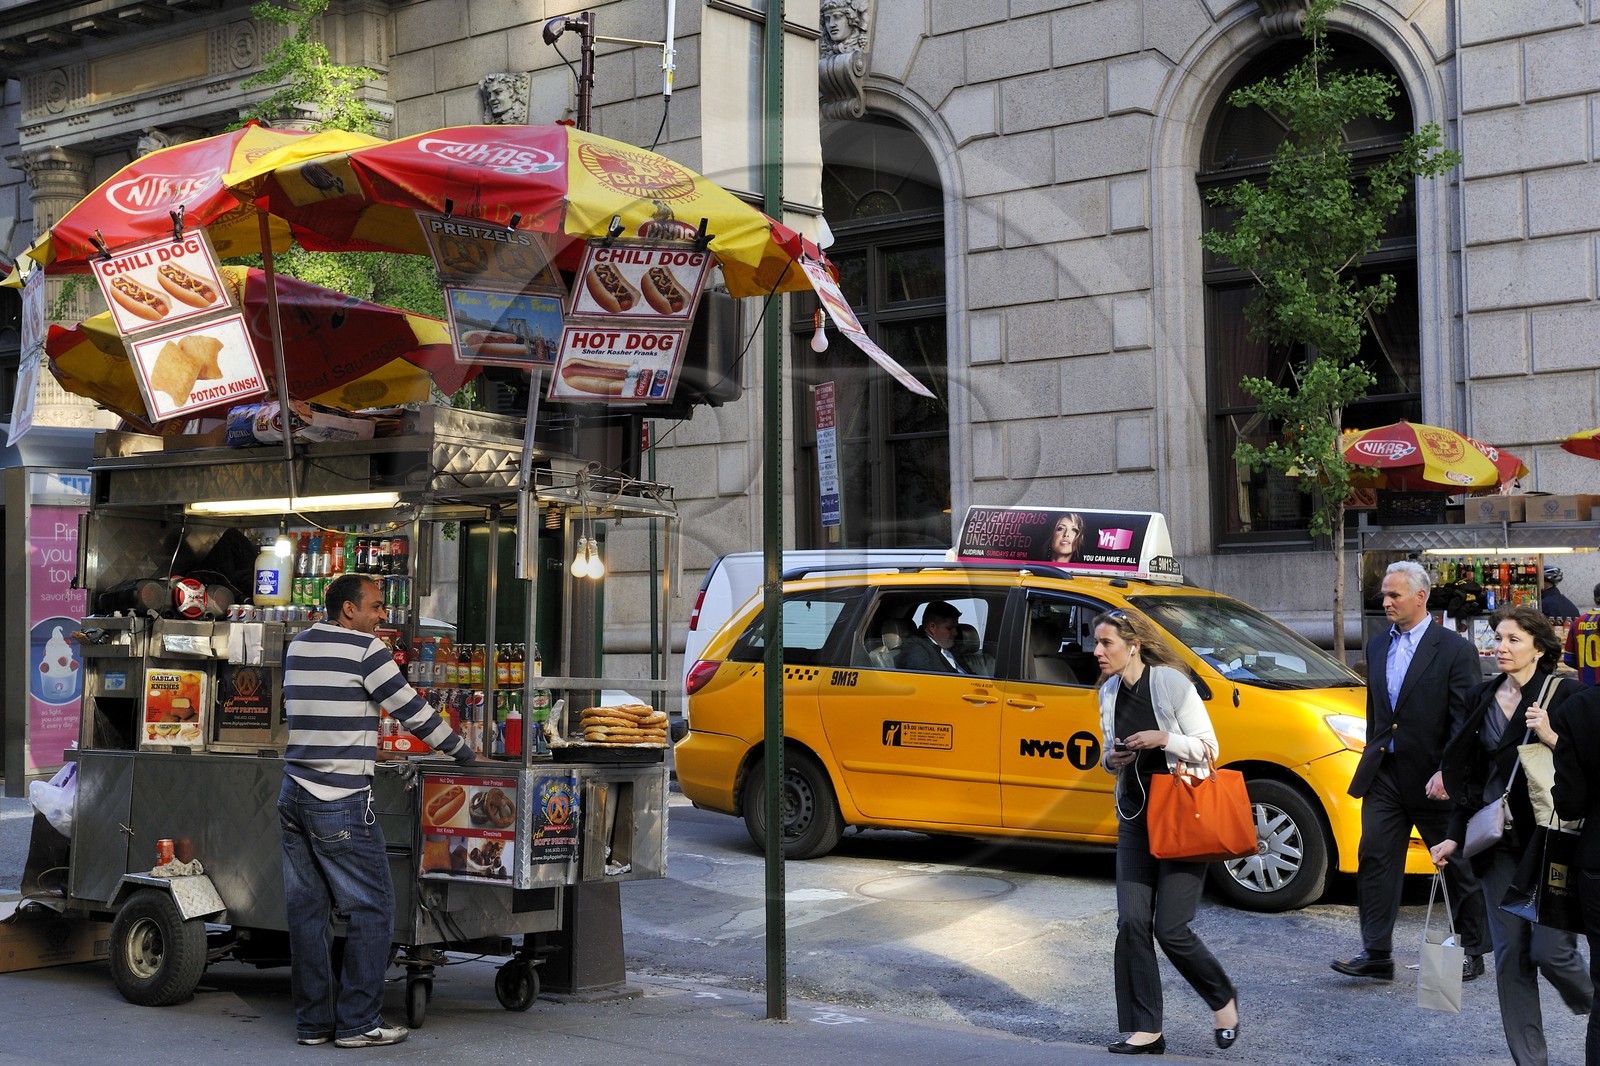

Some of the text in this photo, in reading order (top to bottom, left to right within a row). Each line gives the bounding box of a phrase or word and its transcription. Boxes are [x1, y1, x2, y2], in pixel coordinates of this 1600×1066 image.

[438, 142, 538, 166] NIKAS
[126, 175, 210, 207] NIKAS
[430, 219, 532, 247] PRETZELS
[102, 239, 201, 277] CHILI DOG
[594, 249, 704, 267] CHILI DOG
[571, 332, 674, 351] HOT DOG
[581, 348, 606, 356] Shofar
[606, 349, 633, 357] Kosher
[190, 376, 259, 403] POTATO KINSH
[1363, 441, 1404, 455] NIKAS
[970, 510, 1048, 525] ADVENTUROUS
[967, 521, 1022, 536] BEAUTIFUL
[965, 533, 1032, 548] UNEXPECTED
[985, 549, 1009, 557] SUNDAYS
[1158, 557, 1173, 572] 9M13
[1576, 633, 1600, 668] 10
[830, 670, 859, 687] 9M13
[240, 706, 269, 714] PRETZELS
[1020, 738, 1065, 759] NYC
[483, 830, 502, 838] Chestnuts
[533, 837, 551, 847] SOFT
